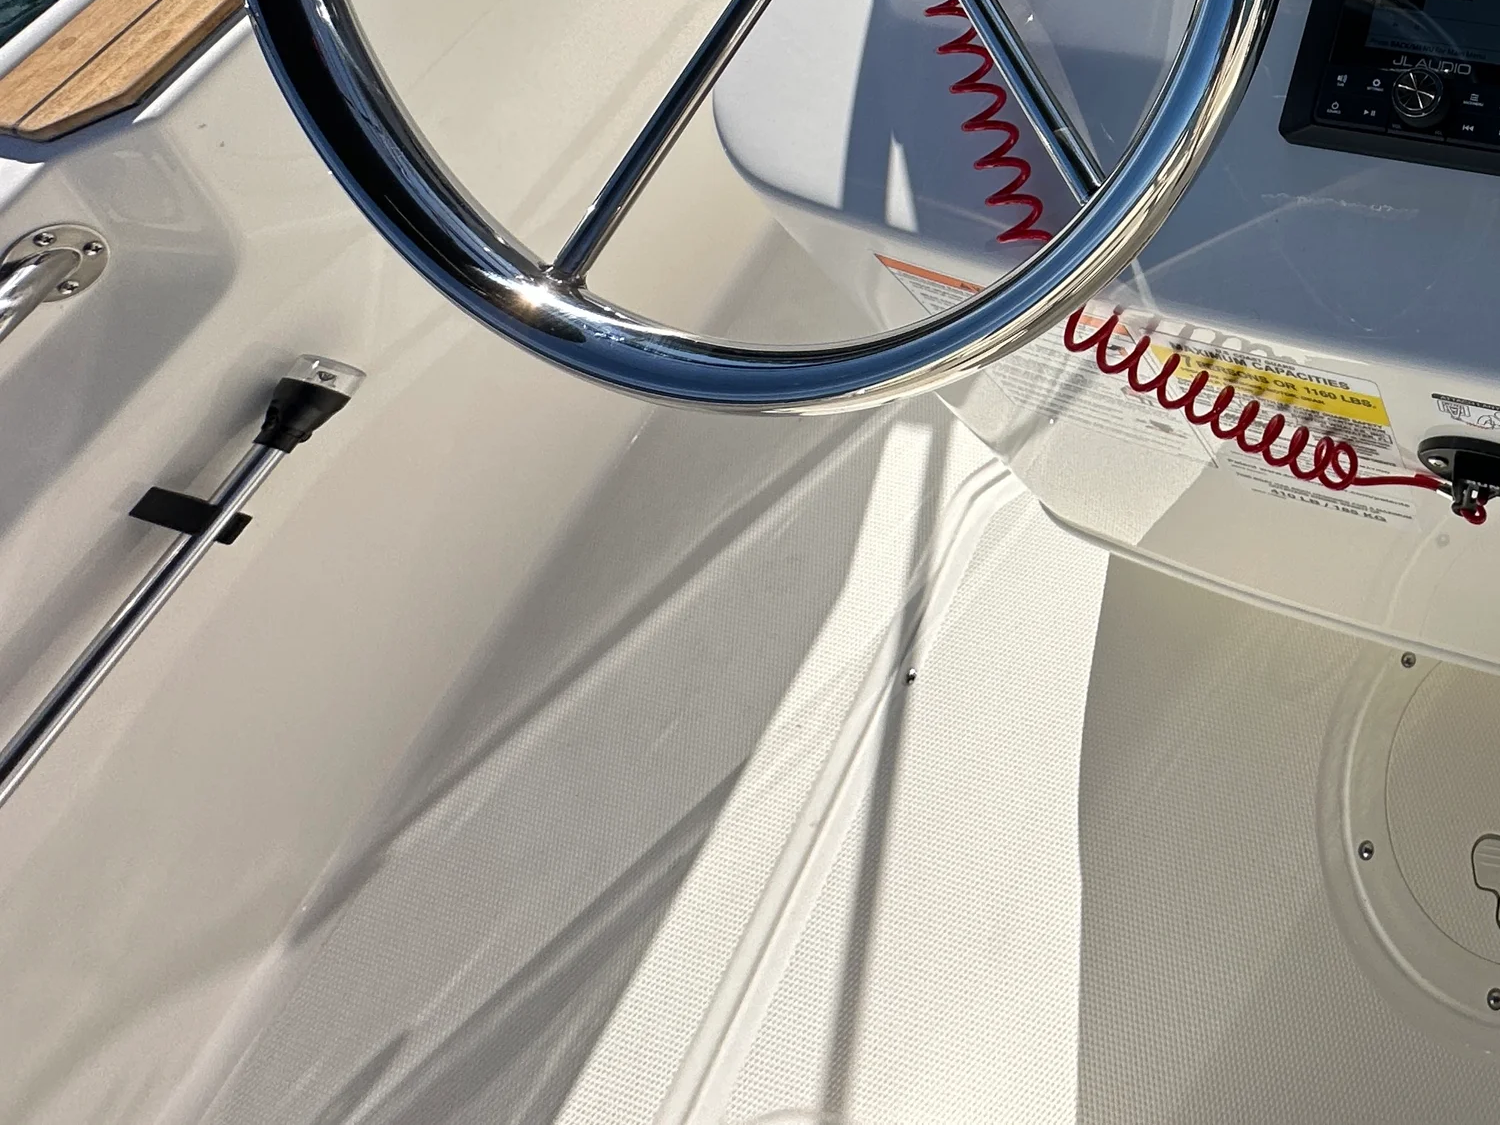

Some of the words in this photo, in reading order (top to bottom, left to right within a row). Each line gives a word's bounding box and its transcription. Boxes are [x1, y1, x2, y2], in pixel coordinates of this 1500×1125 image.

[1392, 55, 1418, 69] JL
[1419, 58, 1472, 76] AUDIO
[1168, 341, 1247, 366] MAXIMUM
[1251, 360, 1350, 390] CAPACITIES
[1180, 353, 1194, 368] 7
[1195, 360, 1269, 384] PERSONS
[1272, 378, 1297, 391] OR
[1303, 385, 1337, 400] 1160
[1339, 393, 1377, 409] LBS.
[1299, 495, 1320, 505] LB
[1362, 511, 1387, 522] KG
